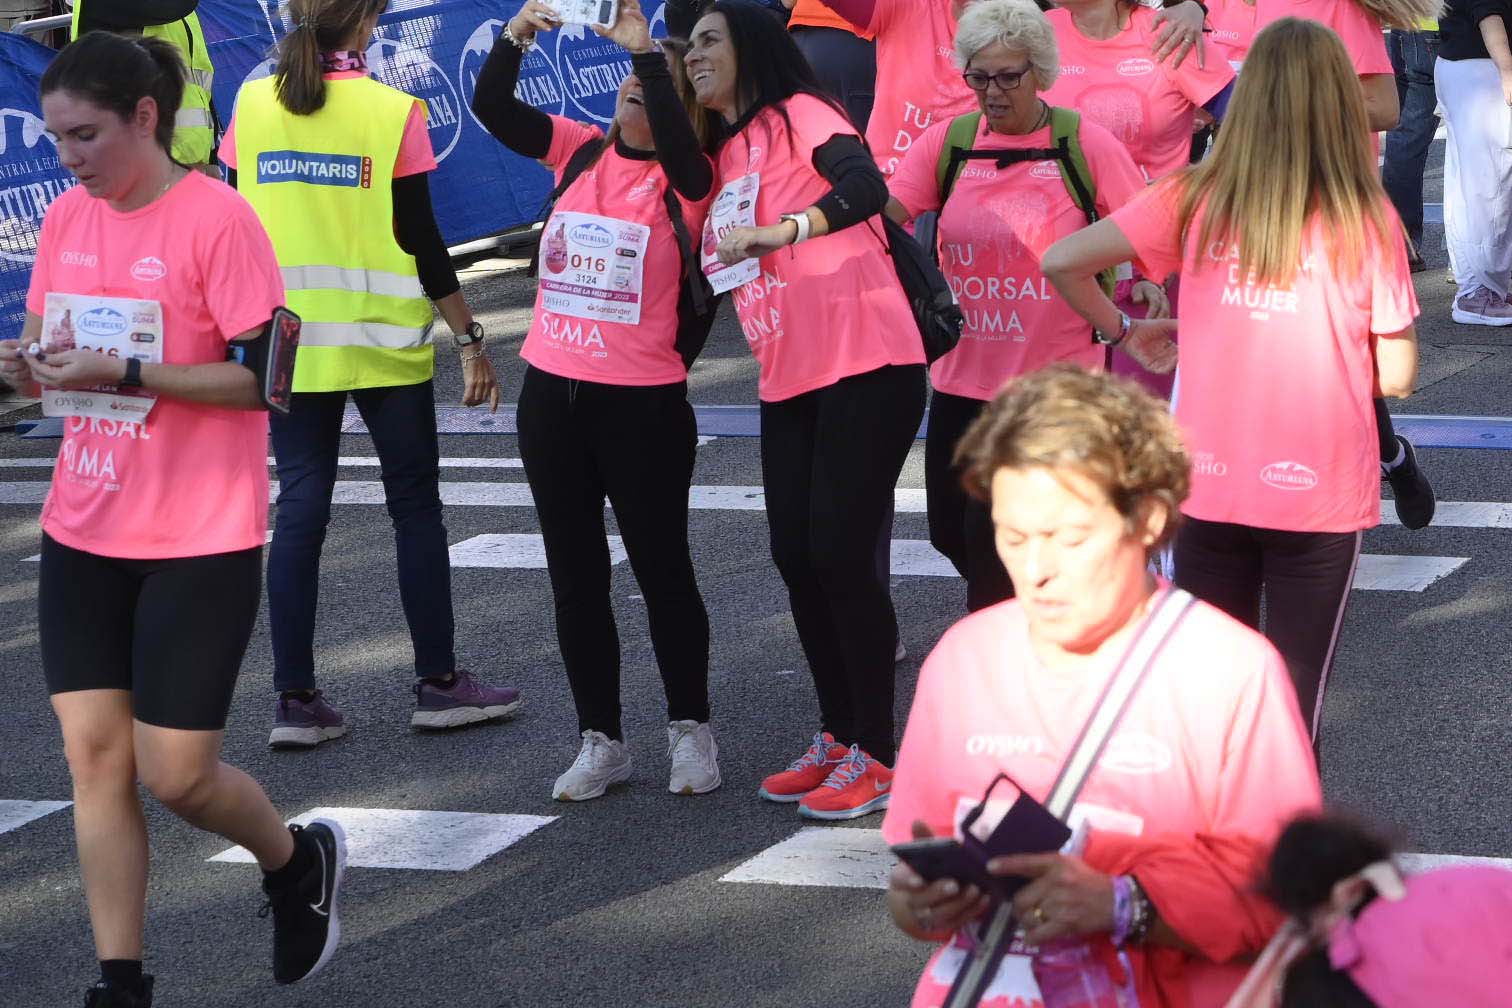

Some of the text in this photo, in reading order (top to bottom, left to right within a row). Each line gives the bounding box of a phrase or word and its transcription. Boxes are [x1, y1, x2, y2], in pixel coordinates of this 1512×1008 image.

[902, 99, 932, 130] TU
[258, 154, 371, 189] VOLUNTARIS 2000
[60, 250, 98, 268] OYSHO
[570, 254, 606, 273] 016
[947, 243, 975, 267] TU
[575, 273, 597, 285] 3124
[951, 276, 1053, 302] DORSAL
[595, 304, 632, 316] Santander
[1220, 286, 1299, 314] MUJER
